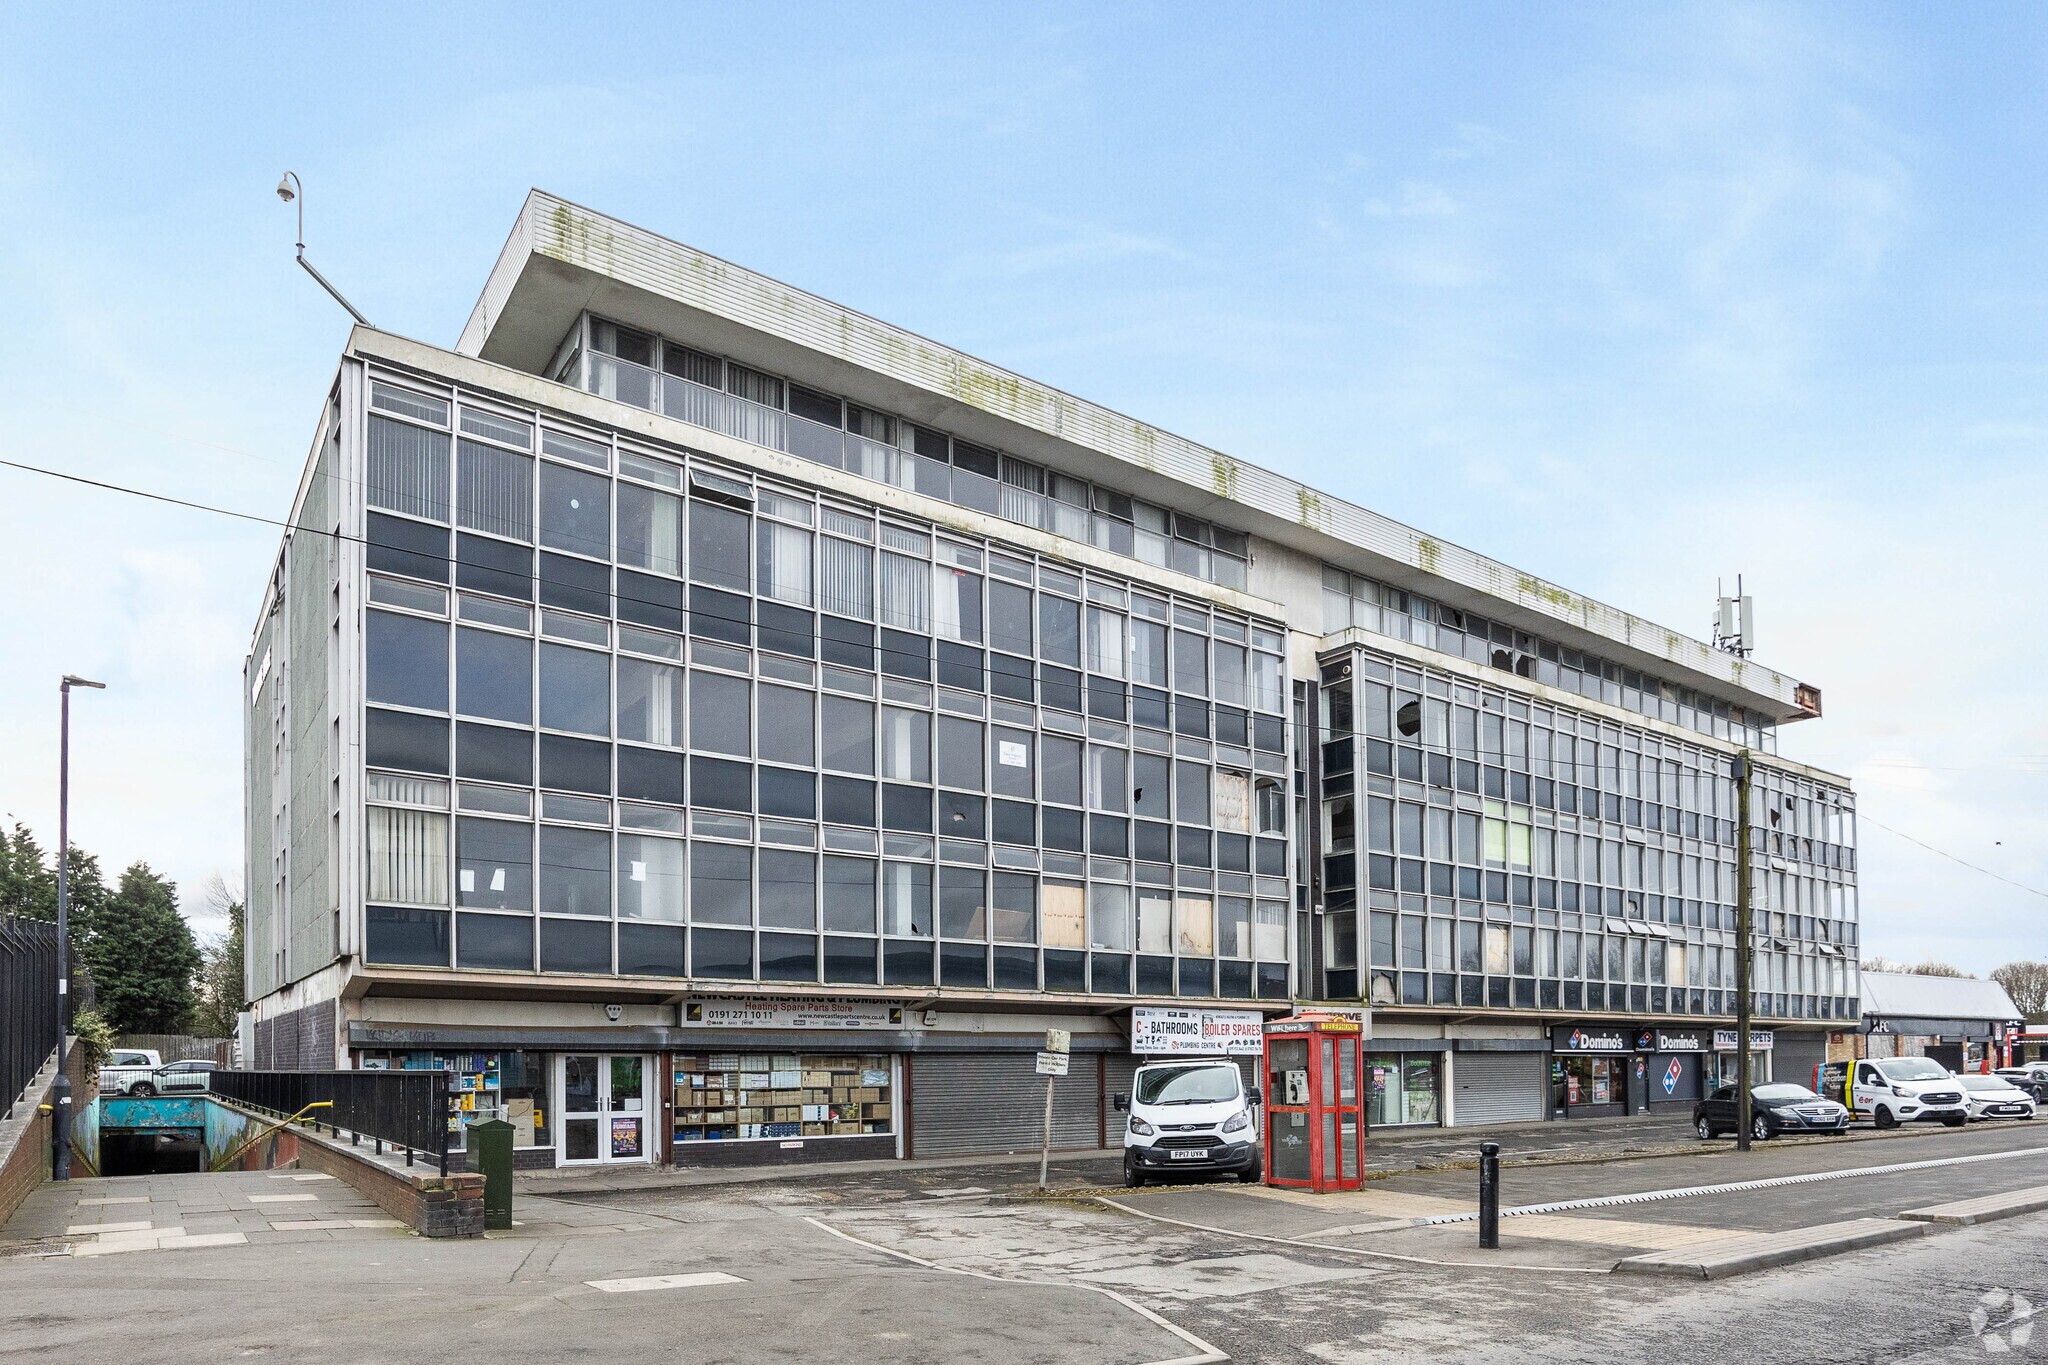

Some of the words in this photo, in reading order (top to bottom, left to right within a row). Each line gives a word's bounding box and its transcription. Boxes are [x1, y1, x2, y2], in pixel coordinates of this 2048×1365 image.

[745, 1002, 778, 1012] Heating
[780, 1003, 805, 1012] Spare
[808, 1003, 829, 1012] Parts
[831, 1004, 853, 1013] Store
[708, 1010, 730, 1019] 0191
[732, 1011, 748, 1019] 271
[798, 1013, 886, 1021] www.newcastlepartscentre.co.uk
[1136, 1021, 1142, 1033] C
[1151, 1021, 1198, 1035] BATHROOMS
[1204, 1023, 1230, 1036] BOILER
[1232, 1024, 1261, 1036] SPARES
[1580, 1032, 1623, 1049] Domino's
[1660, 1034, 1699, 1049] Domino's
[1717, 1032, 1737, 1042] TYNE
[1180, 1041, 1200, 1049] PLUMBING
